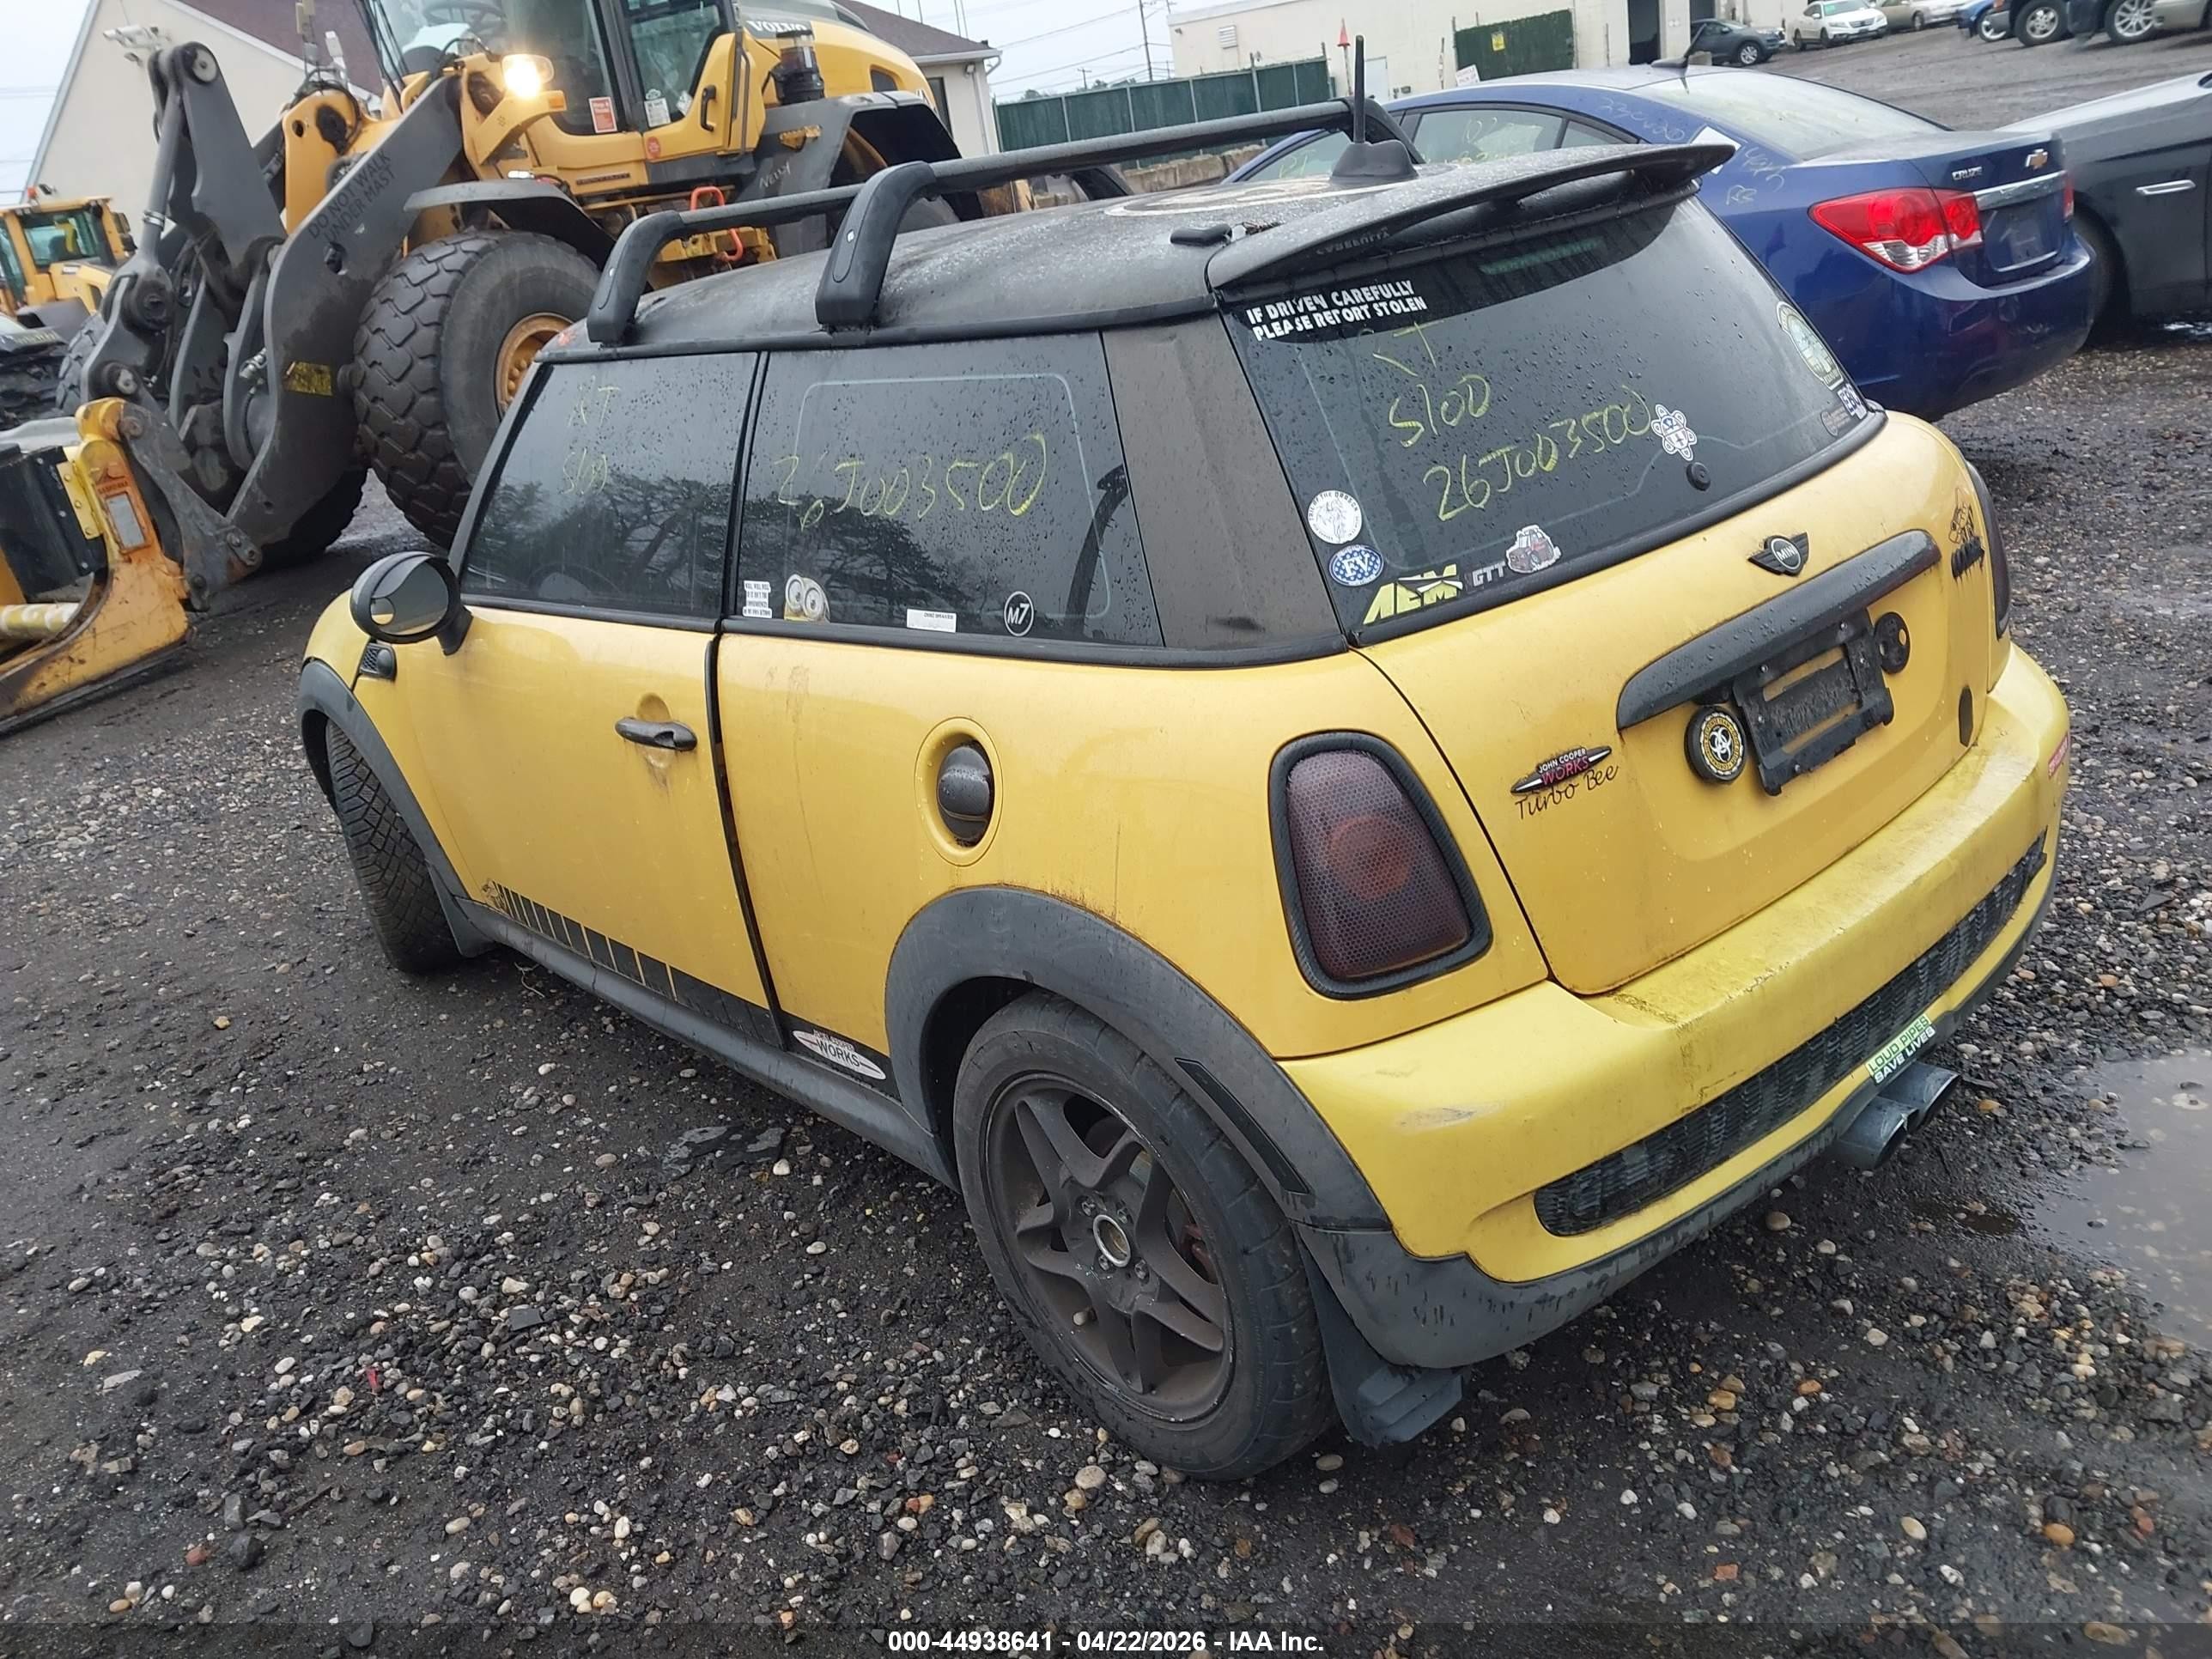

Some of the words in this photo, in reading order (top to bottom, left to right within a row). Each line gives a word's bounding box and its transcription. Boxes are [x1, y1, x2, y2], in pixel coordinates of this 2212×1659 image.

[328, 184, 356, 216] NOT
[354, 149, 392, 188] WALK
[1952, 167, 1983, 180] CRUZE
[324, 198, 366, 241] UNDER
[363, 165, 397, 203] MAST
[1246, 307, 1264, 325] IF
[1265, 294, 1329, 320] DRIVEN
[1330, 280, 1415, 307] CAREFULLY
[1252, 315, 1312, 342] PLEASE
[1375, 296, 1428, 319] STOLEN
[1472, 561, 1507, 587] GTT
[1776, 544, 1799, 561] MINI
[1006, 602, 1030, 625] M7
[1363, 564, 1464, 625] AEM
[1538, 759, 1559, 773] JOHN
[1559, 748, 1587, 764] COOPER
[1541, 756, 1589, 785] WORKS
[1515, 781, 1580, 819] Turbo
[1583, 765, 1619, 791] Bee
[817, 1038, 860, 1067] WORKS
[1868, 1042, 1899, 1072] LOUD
[1899, 1016, 1929, 1047] PIPES
[1874, 1052, 1905, 1083] SAVE
[1905, 1026, 1936, 1057] LIVES
